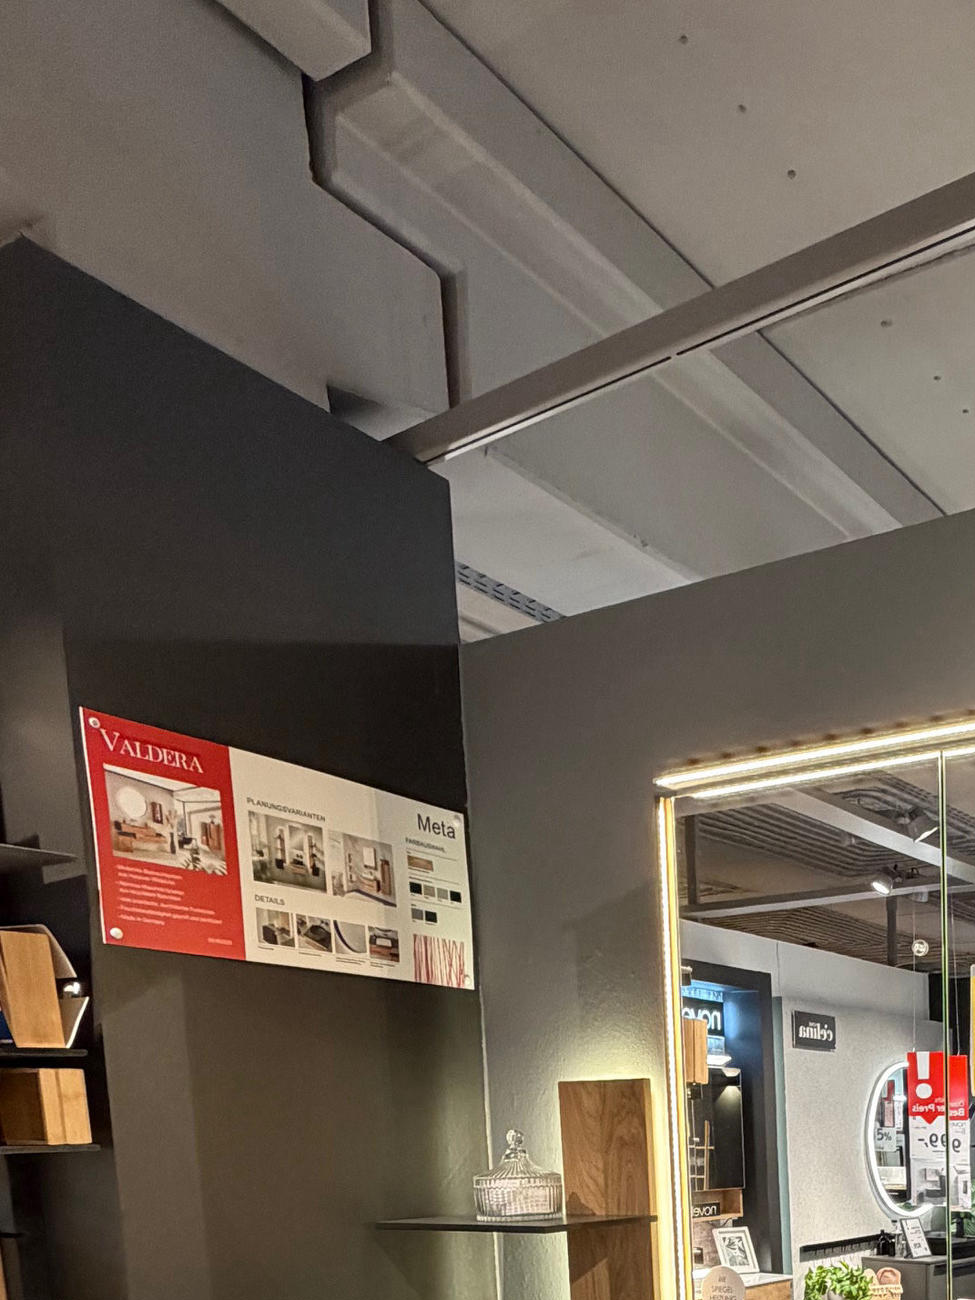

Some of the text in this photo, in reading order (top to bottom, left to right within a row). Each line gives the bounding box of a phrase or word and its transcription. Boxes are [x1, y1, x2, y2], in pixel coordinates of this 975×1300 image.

[99, 727, 204, 775] VALDERA
[416, 813, 457, 840] Meta
[254, 894, 286, 907] DETAILS
